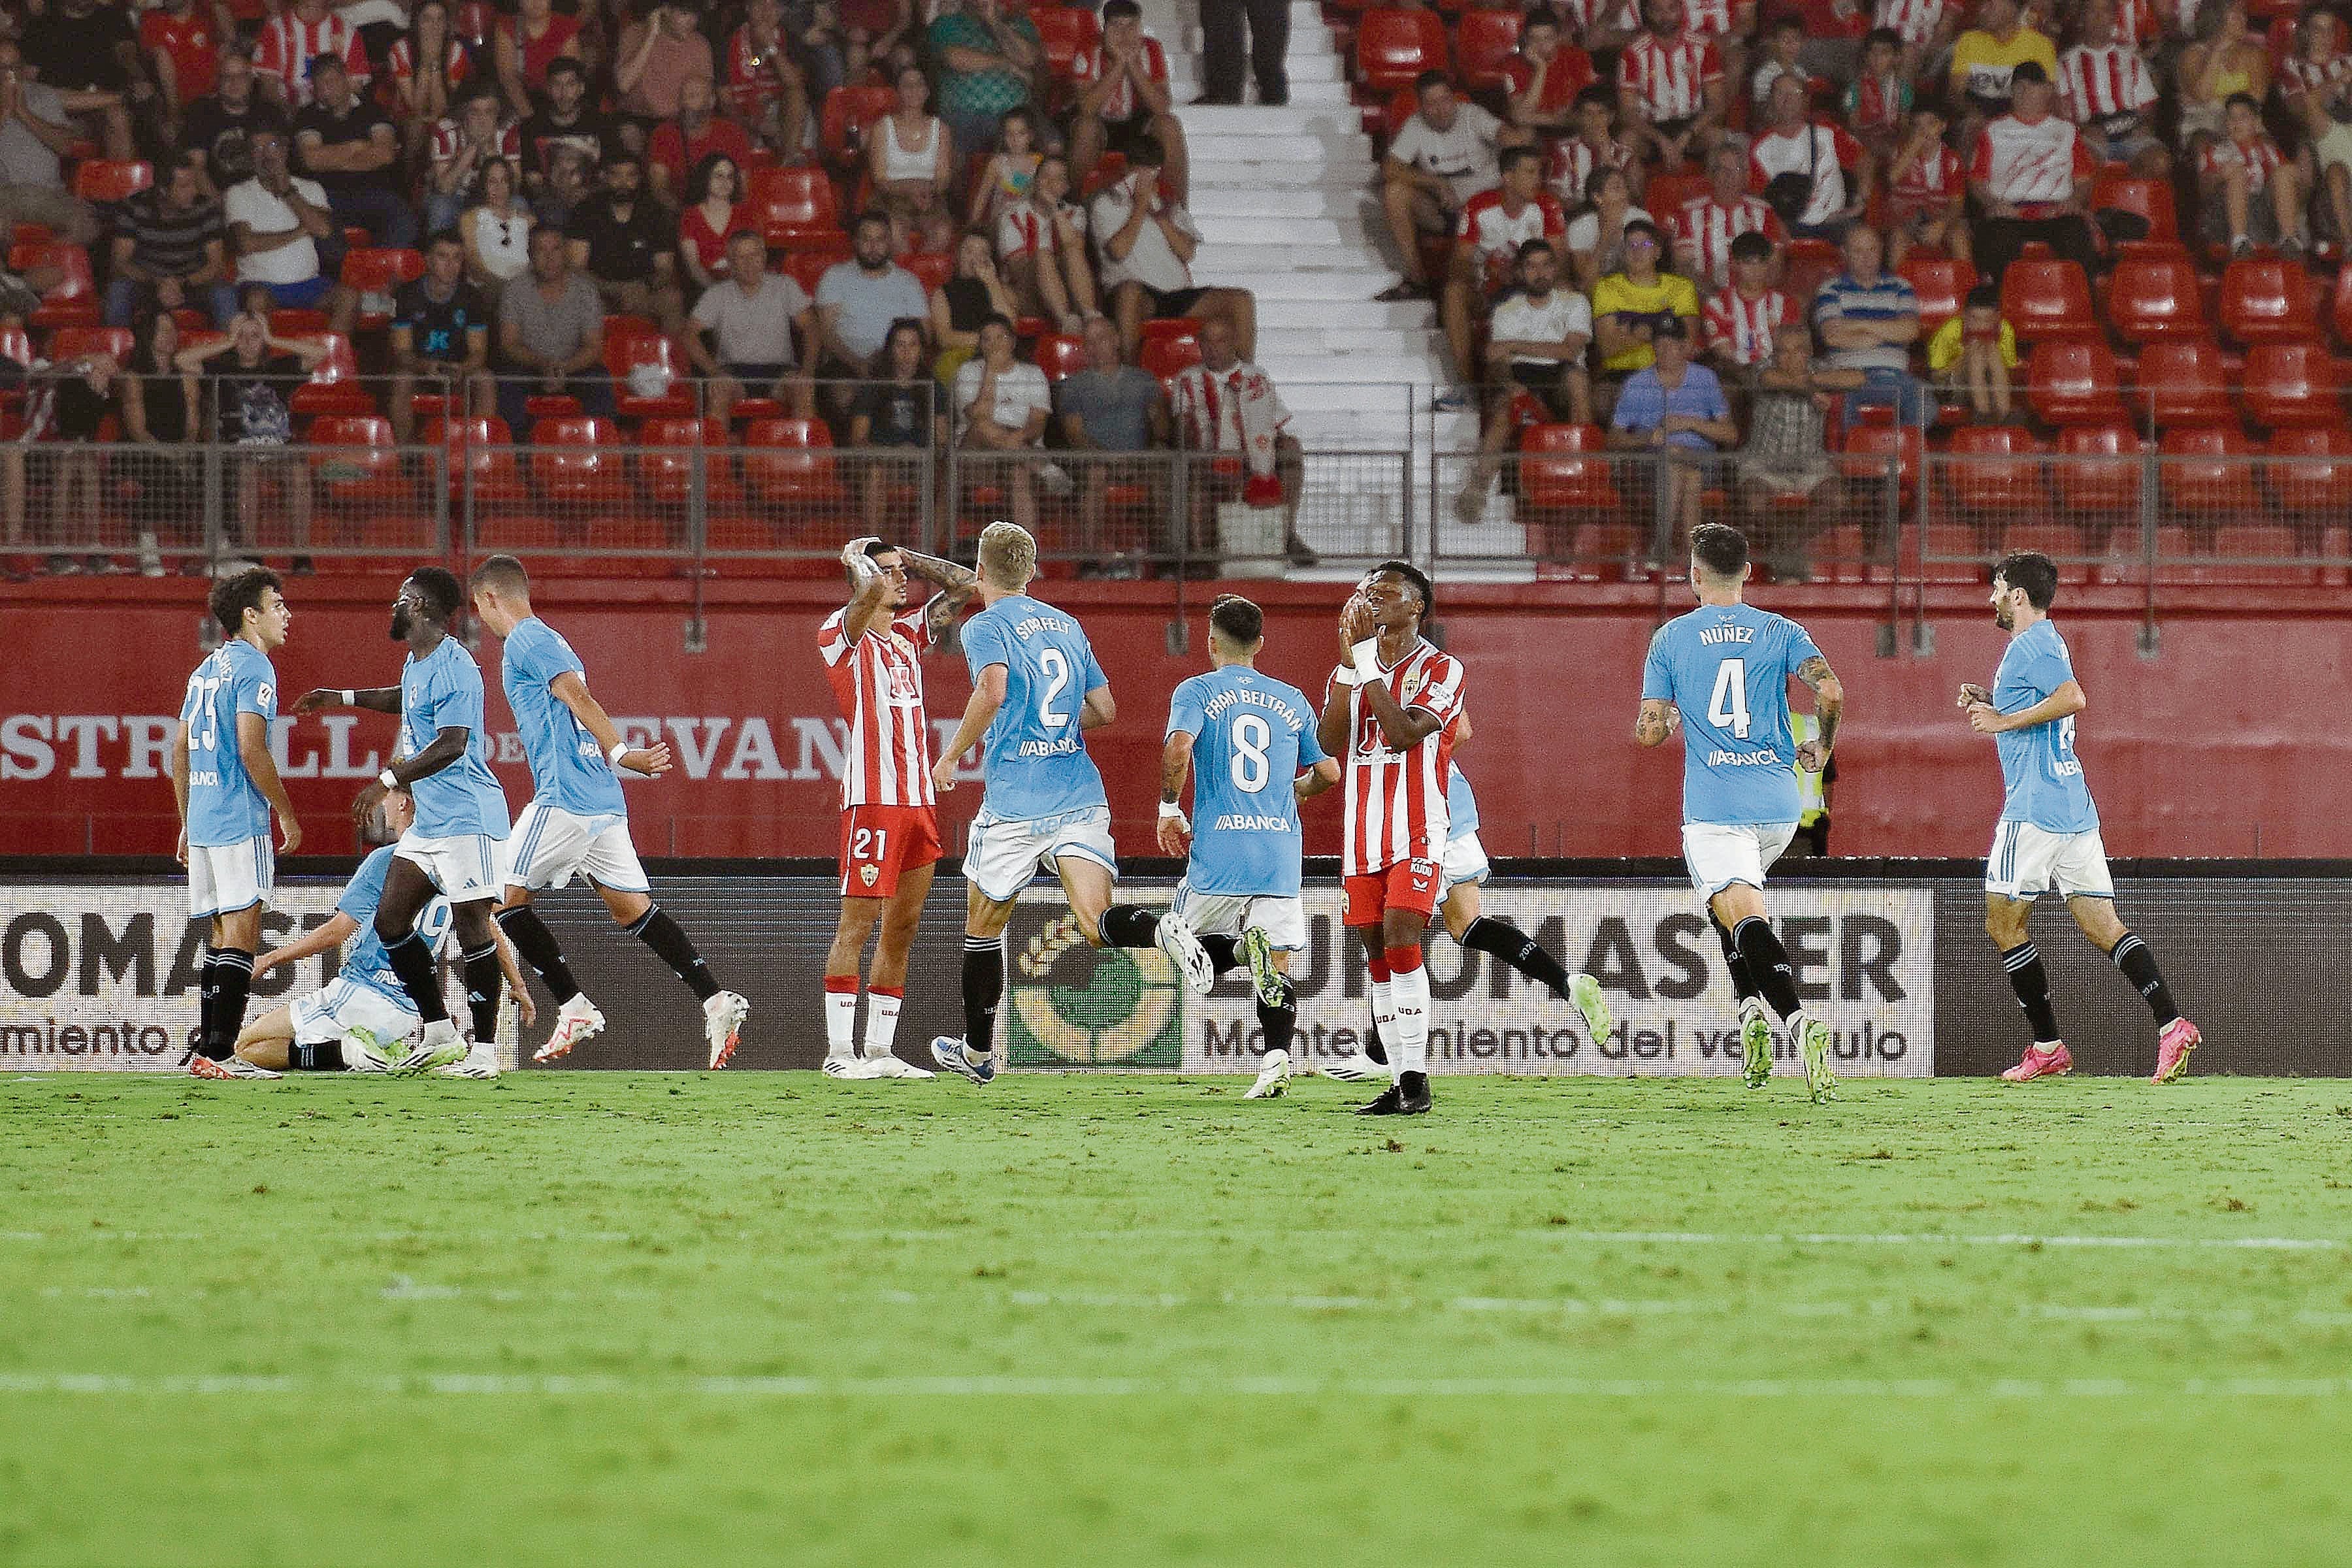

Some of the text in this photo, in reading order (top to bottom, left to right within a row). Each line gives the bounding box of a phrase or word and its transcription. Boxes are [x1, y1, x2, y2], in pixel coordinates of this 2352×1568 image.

[1015, 617, 1071, 642] STARFELT
[1699, 623, 1756, 645] NÚÑEZ
[1040, 647, 1070, 727] 2
[1707, 658, 1752, 739] 4
[186, 674, 221, 752] 23
[1204, 689, 1304, 732] FRAN BELTRÁN
[1231, 713, 1271, 794] 8
[853, 828, 887, 860] 21
[1398, 1006, 1422, 1015] UDA
[1603, 1019, 1676, 1060] del
